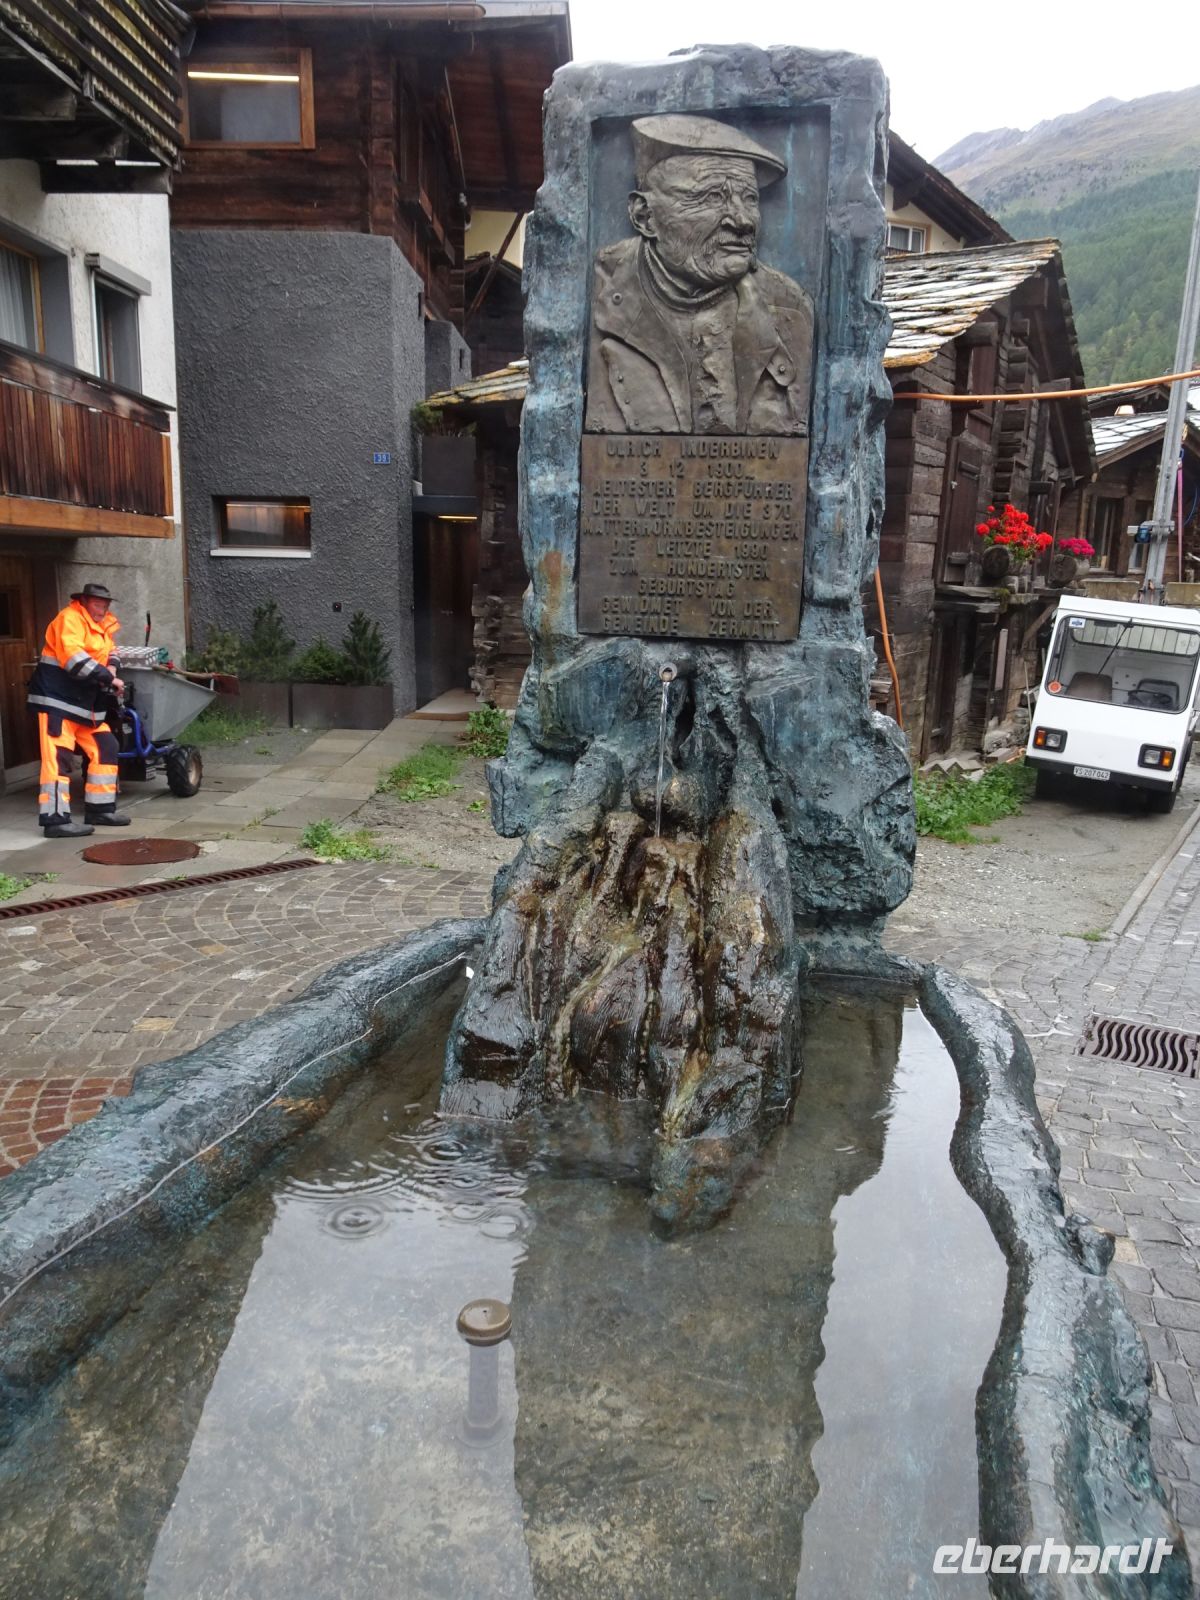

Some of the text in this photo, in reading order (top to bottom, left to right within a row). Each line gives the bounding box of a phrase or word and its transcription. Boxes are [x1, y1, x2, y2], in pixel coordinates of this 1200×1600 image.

[607, 440, 779, 459] ULRICH INDERBINEN
[593, 499, 792, 521] DER WELT UM DIE 370
[582, 518, 799, 541] MATTERHORNBESTEIGUNGEN
[611, 538, 636, 556] DIE
[656, 538, 712, 558] LETZTE
[609, 557, 770, 580] ZUM HUNDERTSTEN
[638, 577, 736, 599] GEBURTSTAG
[602, 595, 774, 619] GEWIDMET VON DER
[603, 614, 780, 639] GEMEINDE ZERMATT
